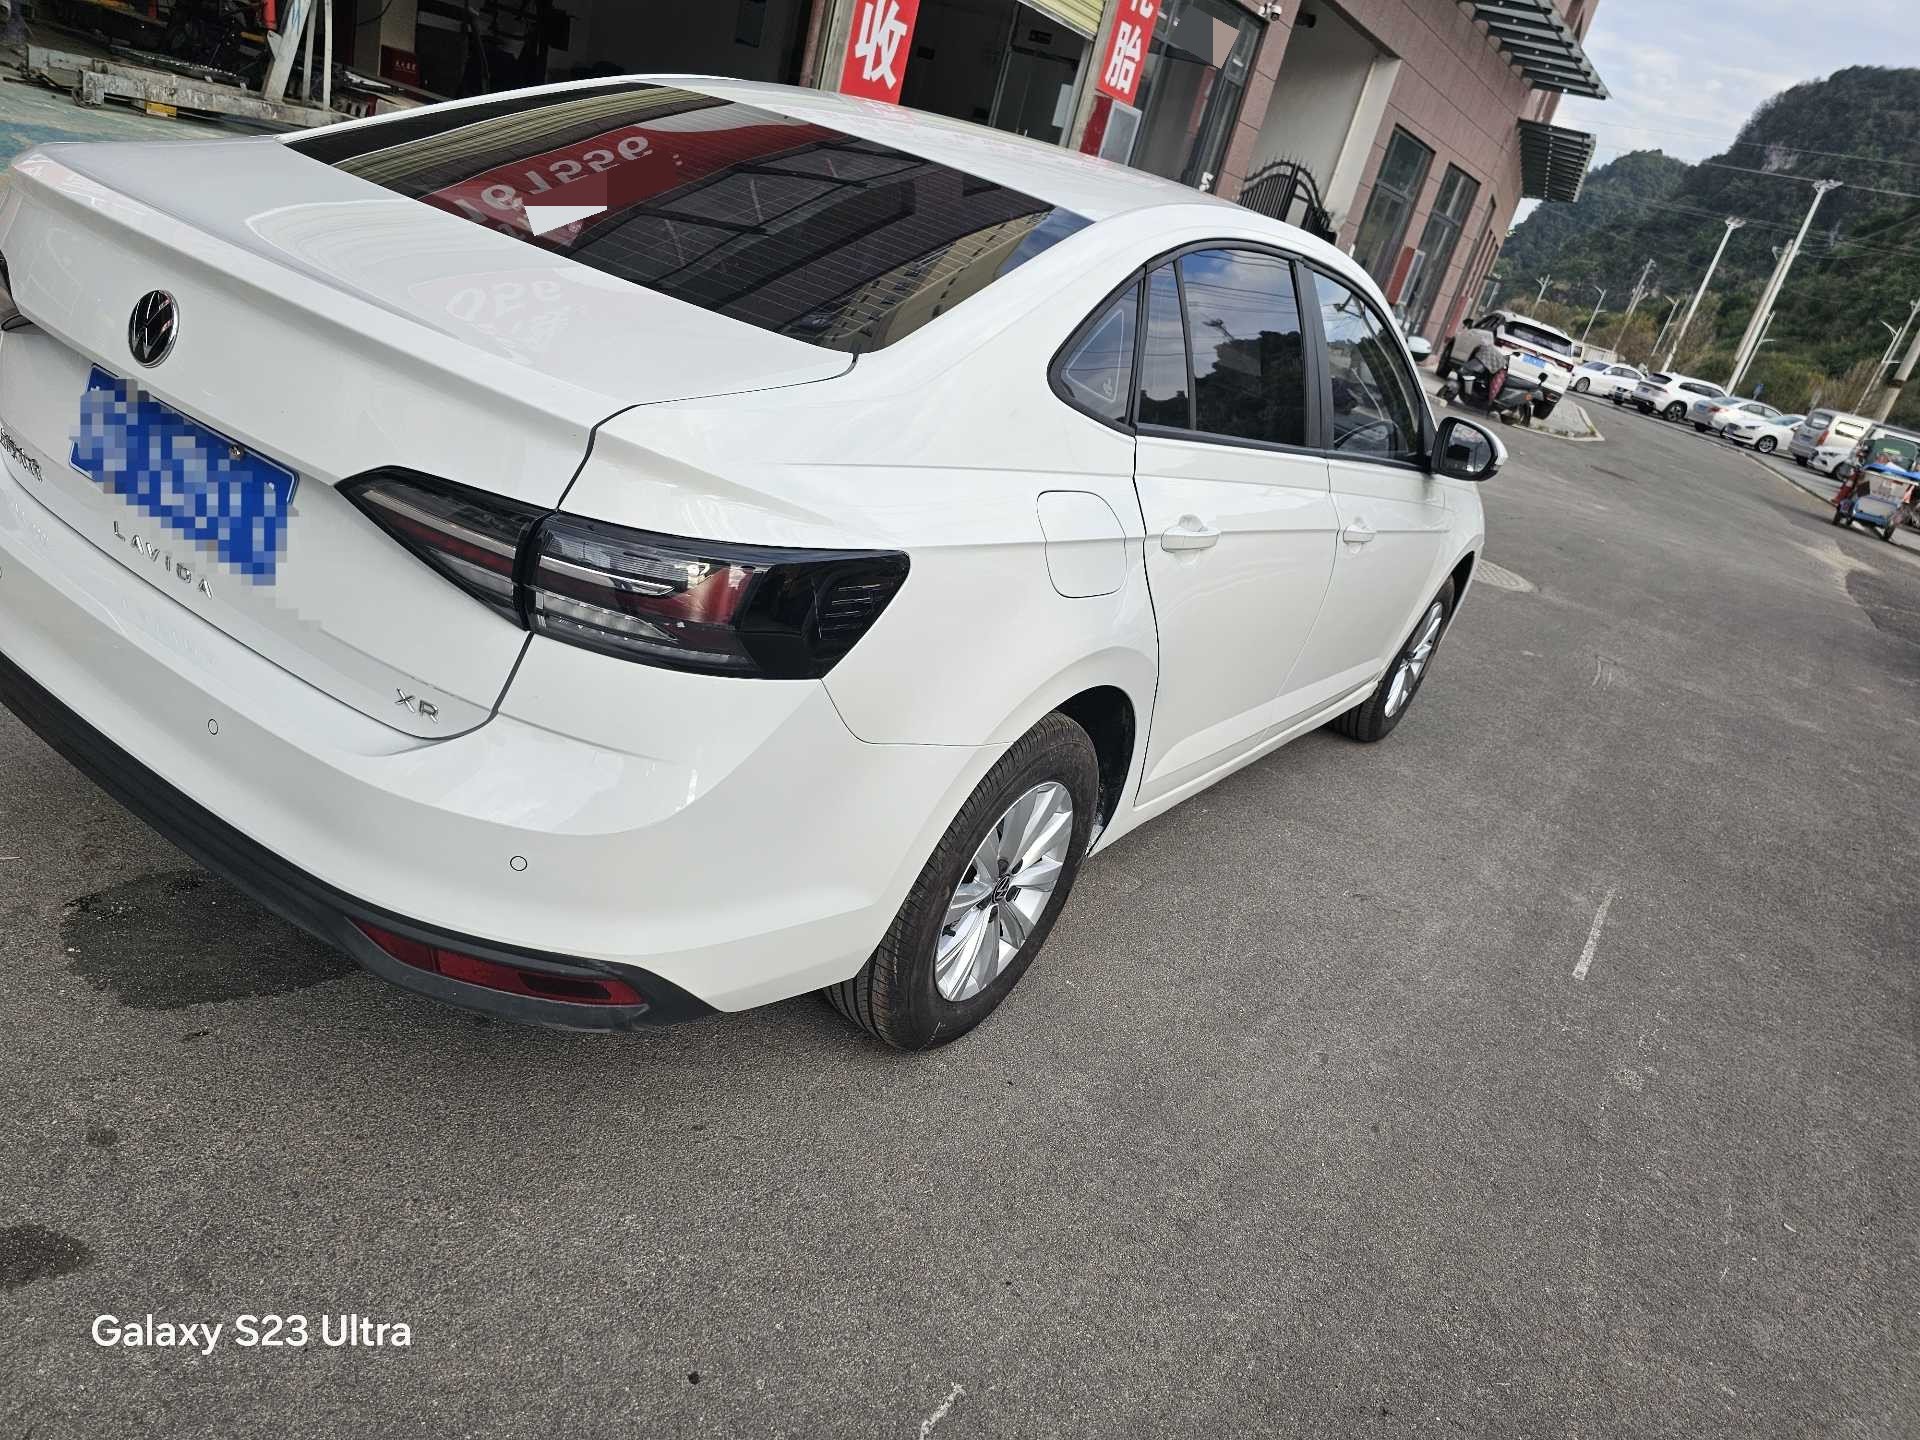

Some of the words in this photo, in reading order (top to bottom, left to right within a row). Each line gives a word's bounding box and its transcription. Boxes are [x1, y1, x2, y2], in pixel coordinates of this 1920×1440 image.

[854, 0, 908, 90] 收
[113, 520, 213, 600] LAVIDA
[395, 688, 440, 723] XR
